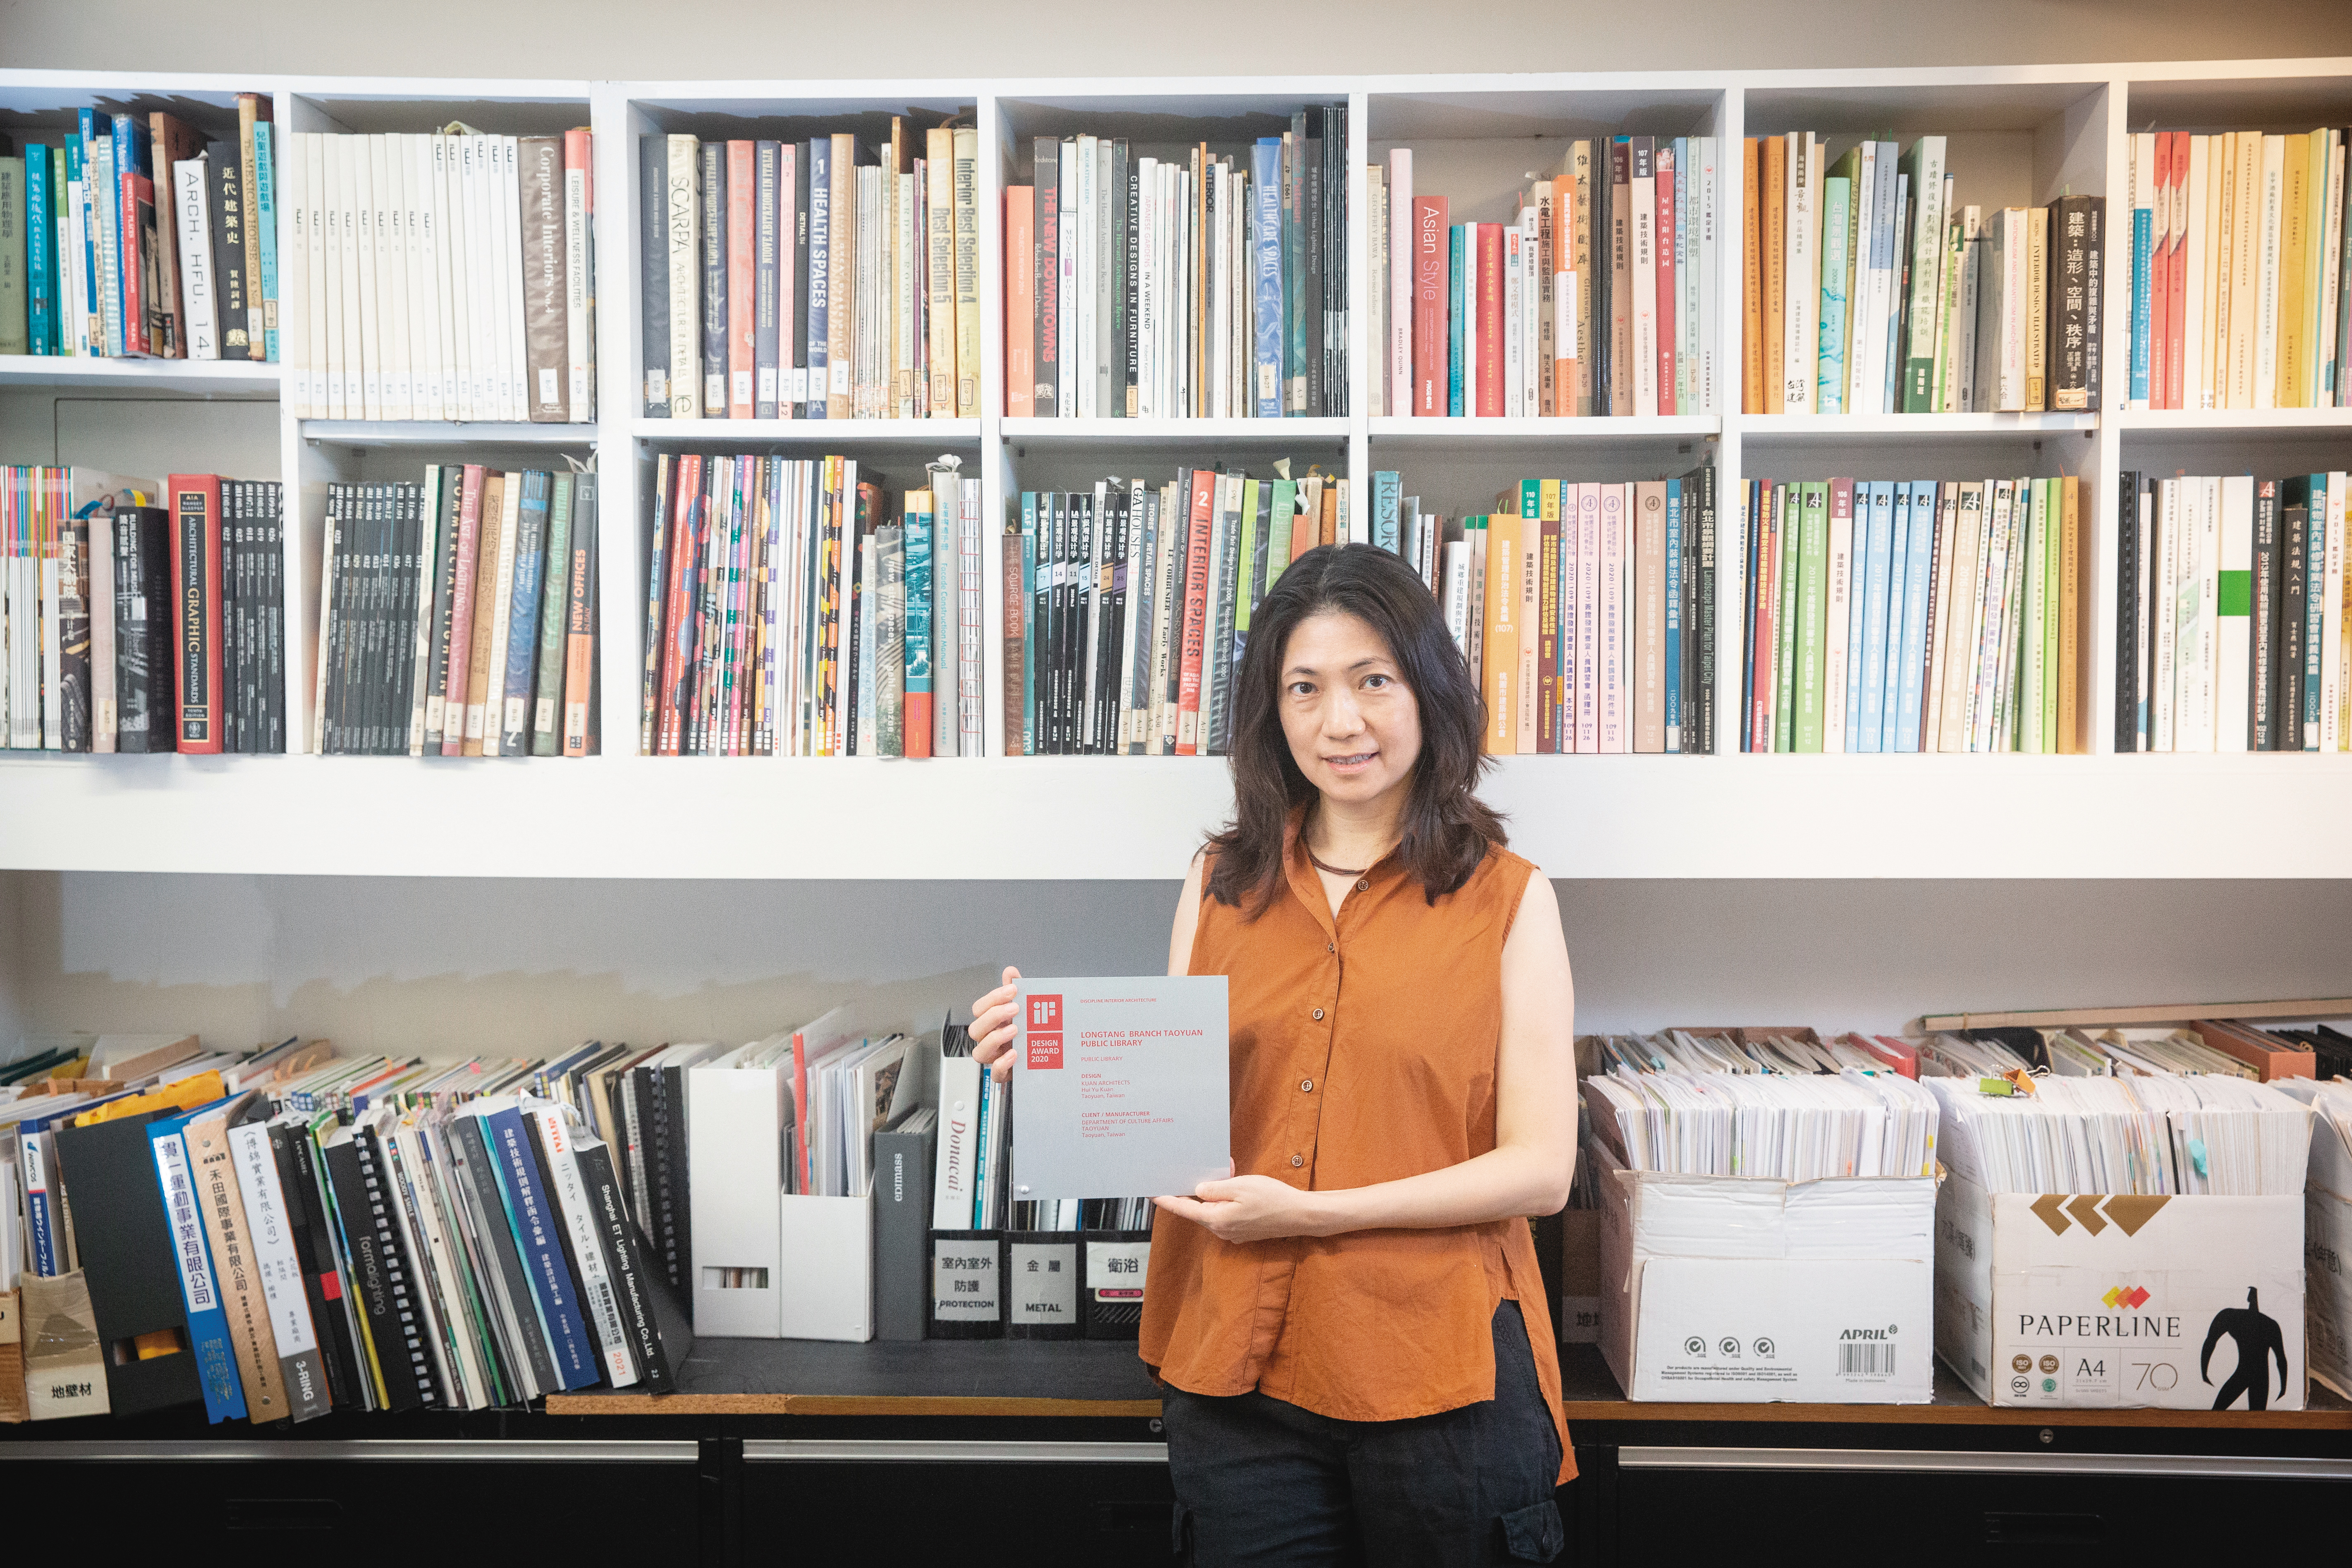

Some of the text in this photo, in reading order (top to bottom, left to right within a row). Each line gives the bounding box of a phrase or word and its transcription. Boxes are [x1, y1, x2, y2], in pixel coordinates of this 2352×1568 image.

[1638, 150, 1648, 176] 107年版
[186, 172, 200, 241] ARCH.
[222, 167, 239, 244] 近代建築史
[536, 146, 557, 314] Corporate Interiors No.4
[672, 178, 691, 254] SCARPA
[957, 158, 976, 303] Interior Best Selection 4
[813, 188, 828, 308] HEALTH SPACES
[932, 208, 951, 303] Best Selection 5
[1263, 185, 1277, 277] HEALTHCARE SPACES
[1420, 206, 1439, 300] Asian Style
[1541, 197, 1551, 302] 水電工程施工與監造實務
[1640, 214, 1648, 264] 建築技術規則
[191, 254, 204, 304] HFU.
[1044, 188, 1056, 362] THE NEW DOWNTOWNS
[1130, 292, 1137, 303] IN
[1144, 272, 1151, 280] IN
[1525, 492, 1535, 517] 110年版
[1545, 493, 1556, 519] 107年版
[1838, 491, 1847, 517] 106年版
[62, 531, 77, 599] 国家大剧院
[1187, 492, 1208, 657] 2 INTERIOR SPACES
[1668, 498, 1679, 630] 臺北市室內裝修法令函釋彙編
[1836, 553, 1845, 602] 建築技術規則
[2290, 520, 2301, 595] 建築法規入門
[188, 517, 200, 703] ARCHITECTURAL GRAPHIC STANDARDS
[572, 549, 586, 631] NEW OFFICES
[1495, 541, 1514, 633] 建築管理自治法令彙編 (107)
[1473, 569, 1483, 663] 屋頂綠化技術手冊
[1499, 673, 1507, 737] 桃園市建築師公會
[548, 1117, 564, 1153] NITTAI
[947, 1119, 966, 1193] Donacai
[27, 1152, 38, 1183] WINCOS
[602, 1184, 617, 1223] Shanghai
[210, 1169, 247, 1292] 禾田國際事業有限公司
[612, 1224, 622, 1236] ET
[616, 1239, 630, 1270] Lighting
[359, 1235, 386, 1315] formalighting
[942, 1257, 992, 1269] 室內室外
[954, 1280, 980, 1293] 防護
[1027, 1260, 1060, 1273] 金屬
[1108, 1259, 1138, 1273] 衛浴
[625, 1273, 646, 1325] Manufacturing
[1026, 1303, 1062, 1312] METAL
[1840, 1329, 1888, 1340] APRIL
[2019, 1315, 2180, 1337] PAPERLINE
[295, 1360, 314, 1401] 3-RING
[613, 1351, 626, 1376] 2021
[2077, 1359, 2106, 1376] A4
[2132, 1363, 2178, 1391] 70
[52, 1382, 92, 1398] 地壁材
